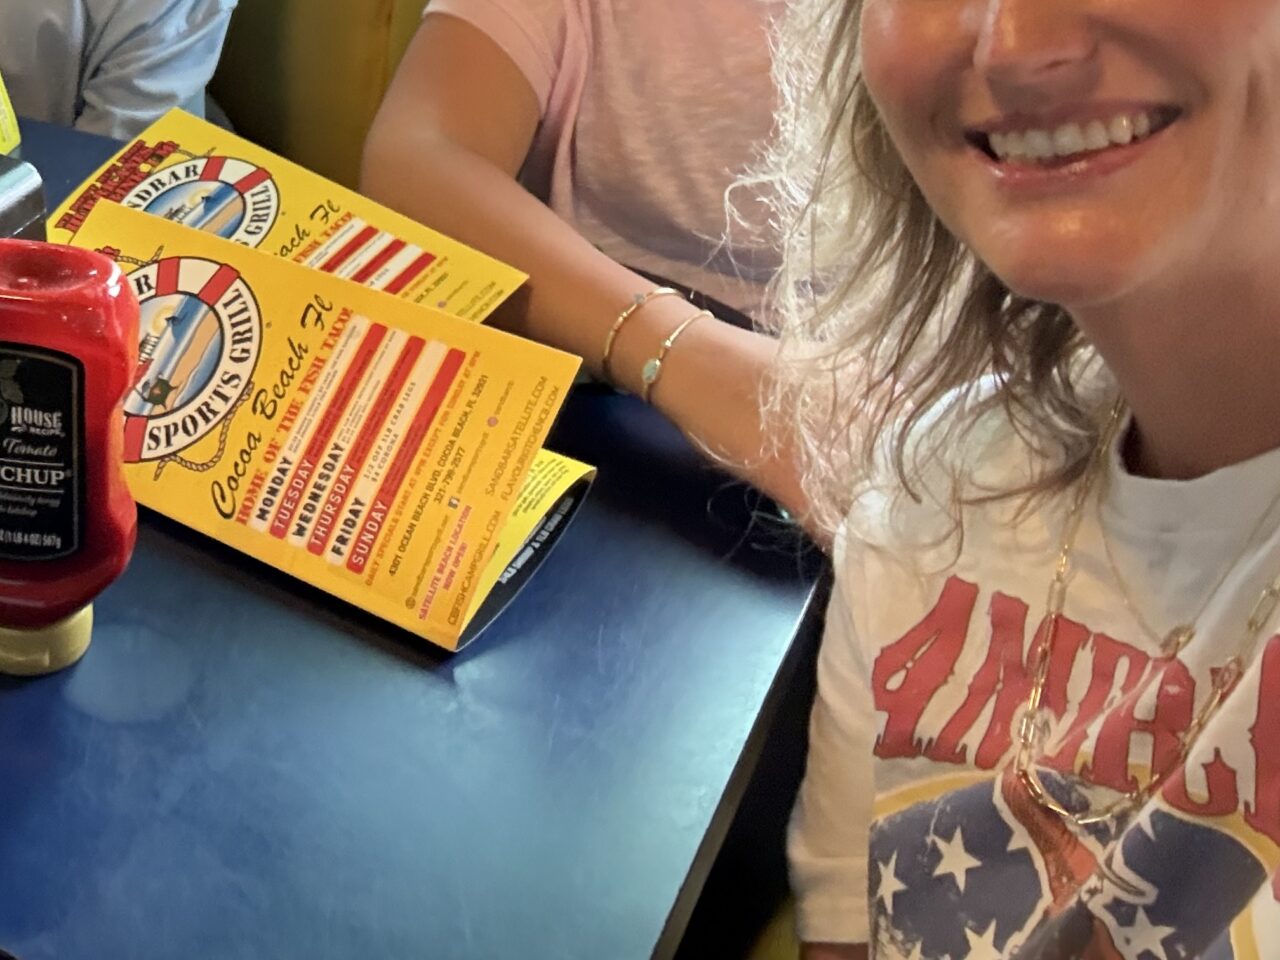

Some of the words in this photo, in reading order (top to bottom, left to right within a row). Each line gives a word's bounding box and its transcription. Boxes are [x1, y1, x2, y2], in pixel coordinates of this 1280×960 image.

[245, 184, 272, 236] GRILL
[147, 371, 242, 450] SPORTS
[222, 288, 253, 364] GRILL
[11, 406, 62, 428] HOUSE
[211, 431, 262, 520] Cocoa
[251, 337, 309, 420] Beach
[300, 294, 333, 332] Fl
[235, 469, 267, 525] HOME
[263, 437, 280, 464] OF
[277, 397, 304, 433] THE
[297, 356, 327, 396] FISH
[370, 444, 384, 463] OFF
[389, 401, 405, 426] CRAB
[401, 380, 417, 402] LEGS
[2, 438, 58, 457] Tomato
[376, 431, 400, 470] CORONA
[396, 520, 416, 553] OCEAN
[410, 490, 429, 521] BEACH
[435, 437, 455, 467] COCOA
[463, 396, 475, 409] FL
[256, 455, 293, 521] MONDAY
[273, 459, 314, 529] TUESDAY
[292, 442, 344, 537] WEDNESDAY
[311, 463, 356, 546] THURSDAY
[332, 496, 366, 556] FRIDAY
[352, 501, 388, 565] SUNDAY
[416, 573, 440, 620] SATELLITE
[433, 543, 453, 574] BEACH
[447, 503, 471, 545] LOCATION
[440, 567, 456, 590] NOW
